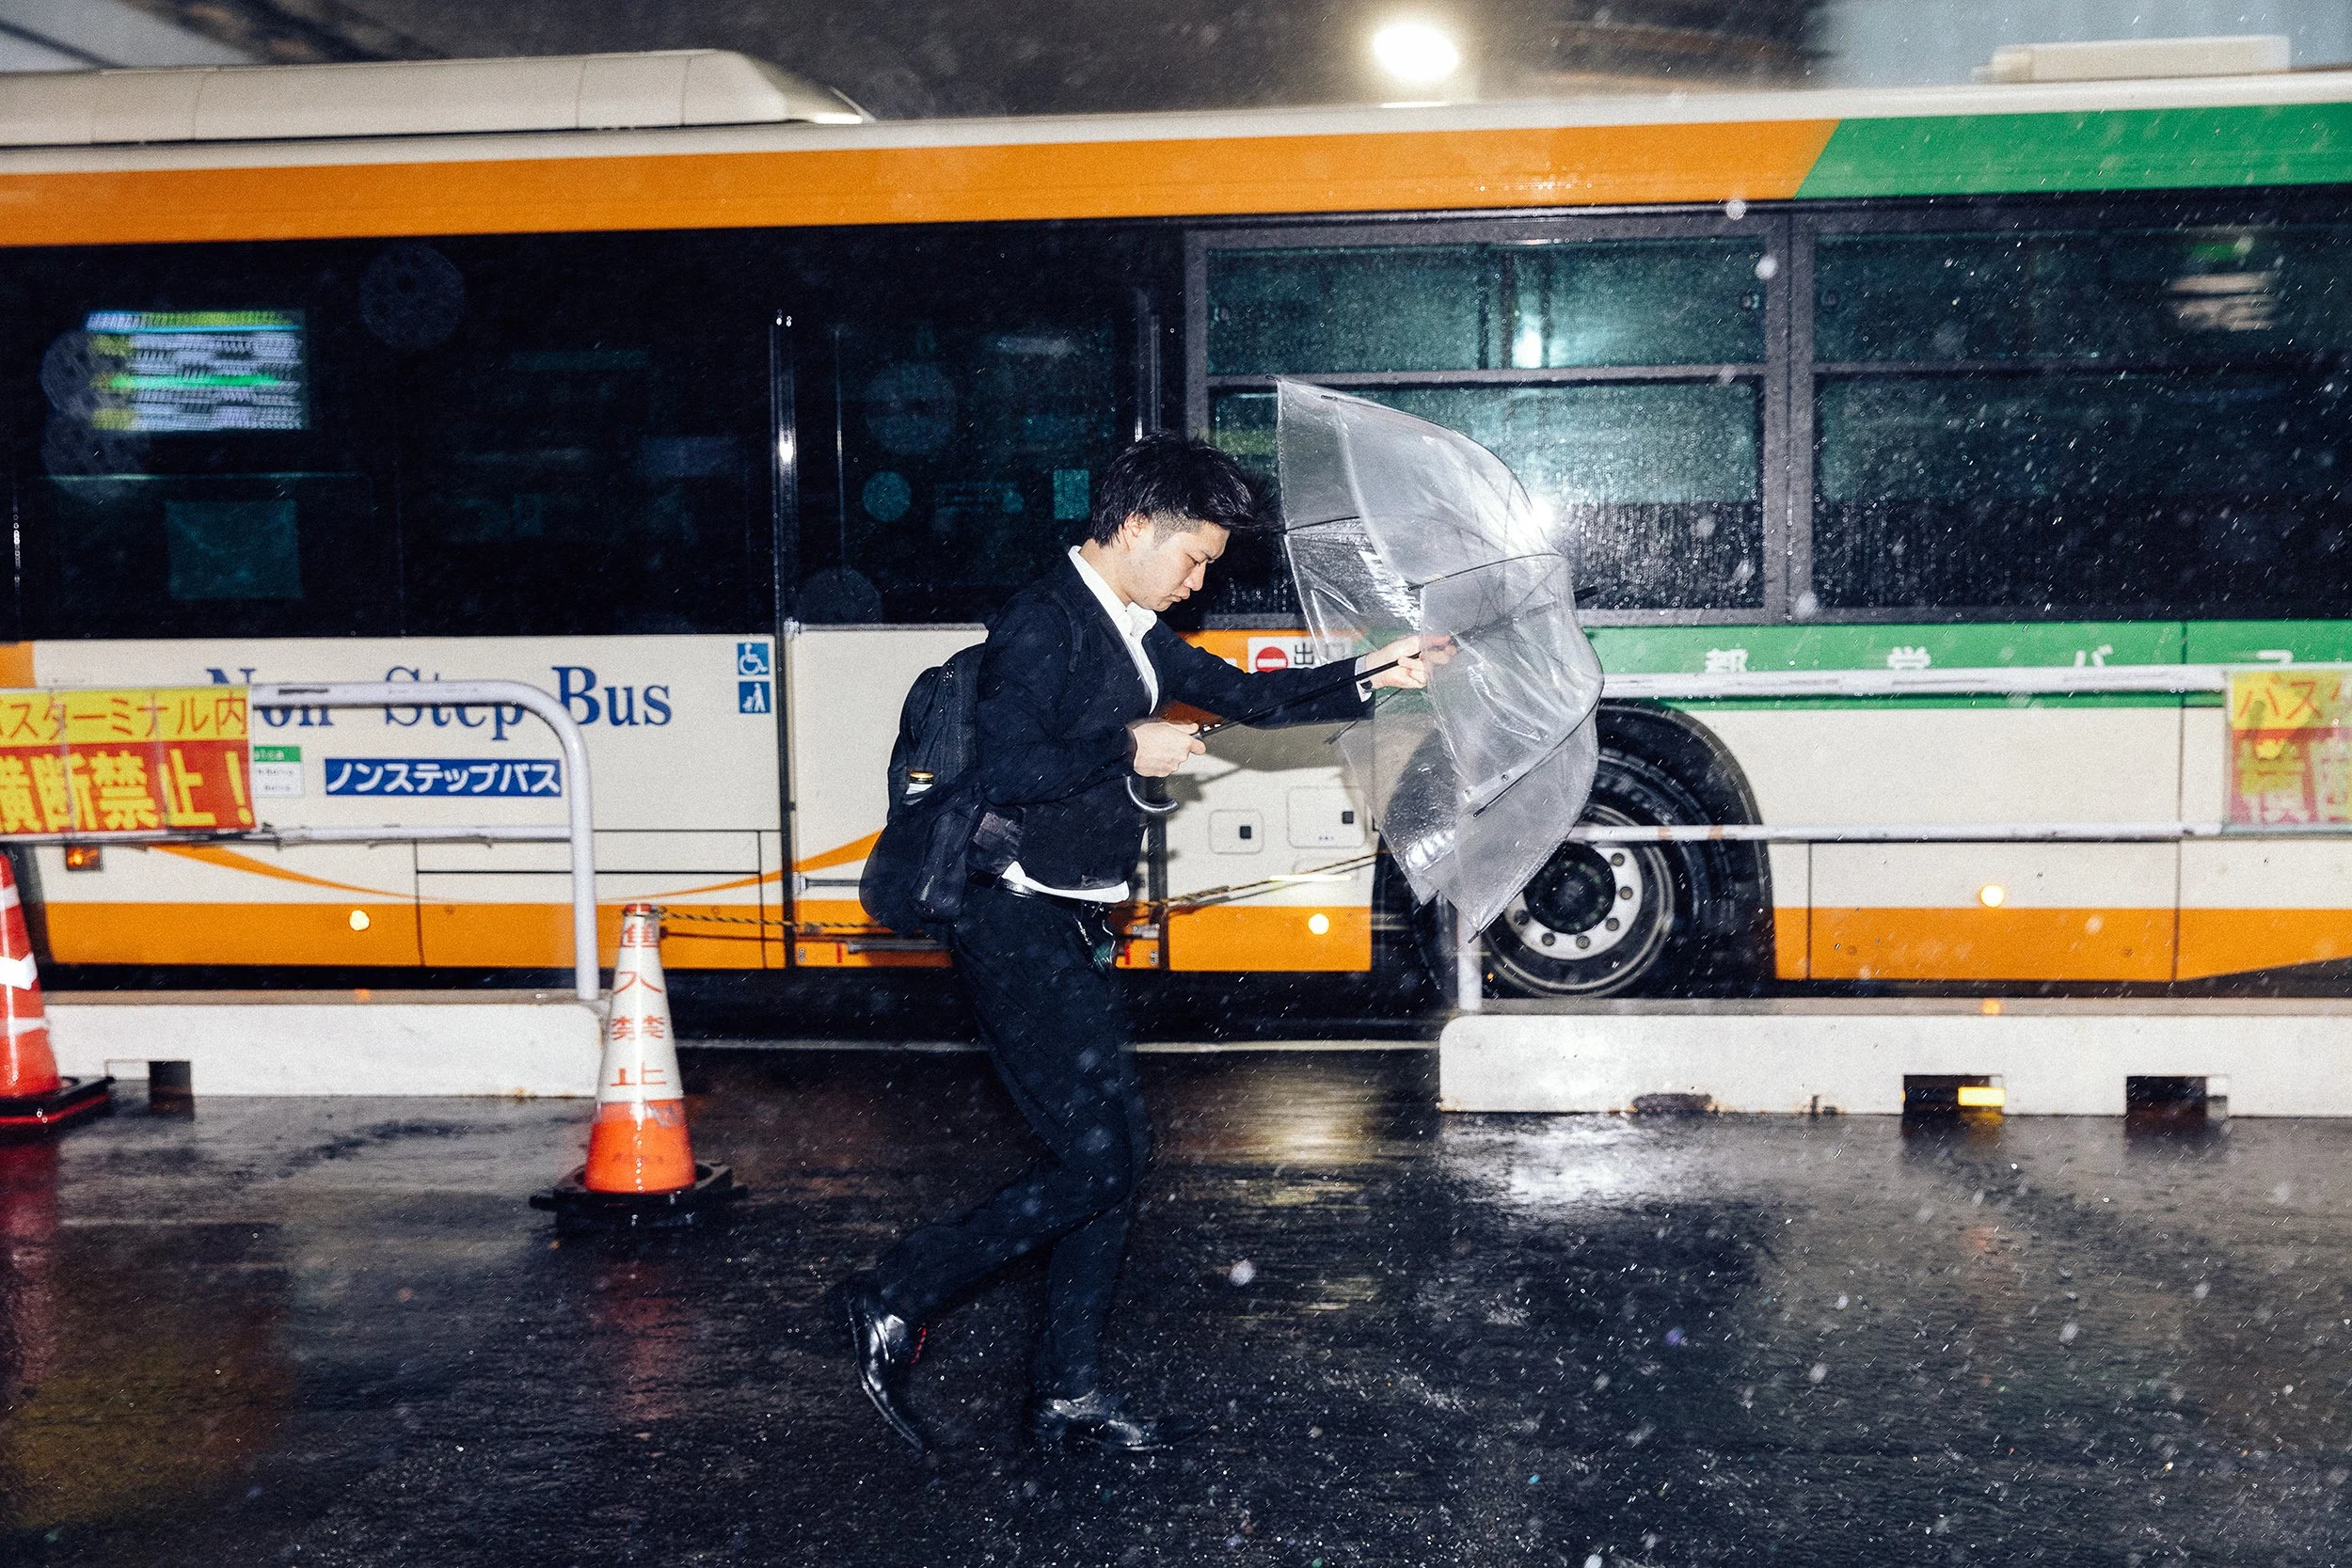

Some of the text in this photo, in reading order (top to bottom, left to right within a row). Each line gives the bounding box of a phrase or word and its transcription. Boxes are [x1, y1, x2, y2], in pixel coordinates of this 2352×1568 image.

[1294, 642, 1345, 665] 出口
[0, 690, 247, 740] スターミナル内
[551, 666, 672, 728] Bus
[2238, 673, 2343, 721] バス
[326, 762, 561, 794] ノンステップバス
